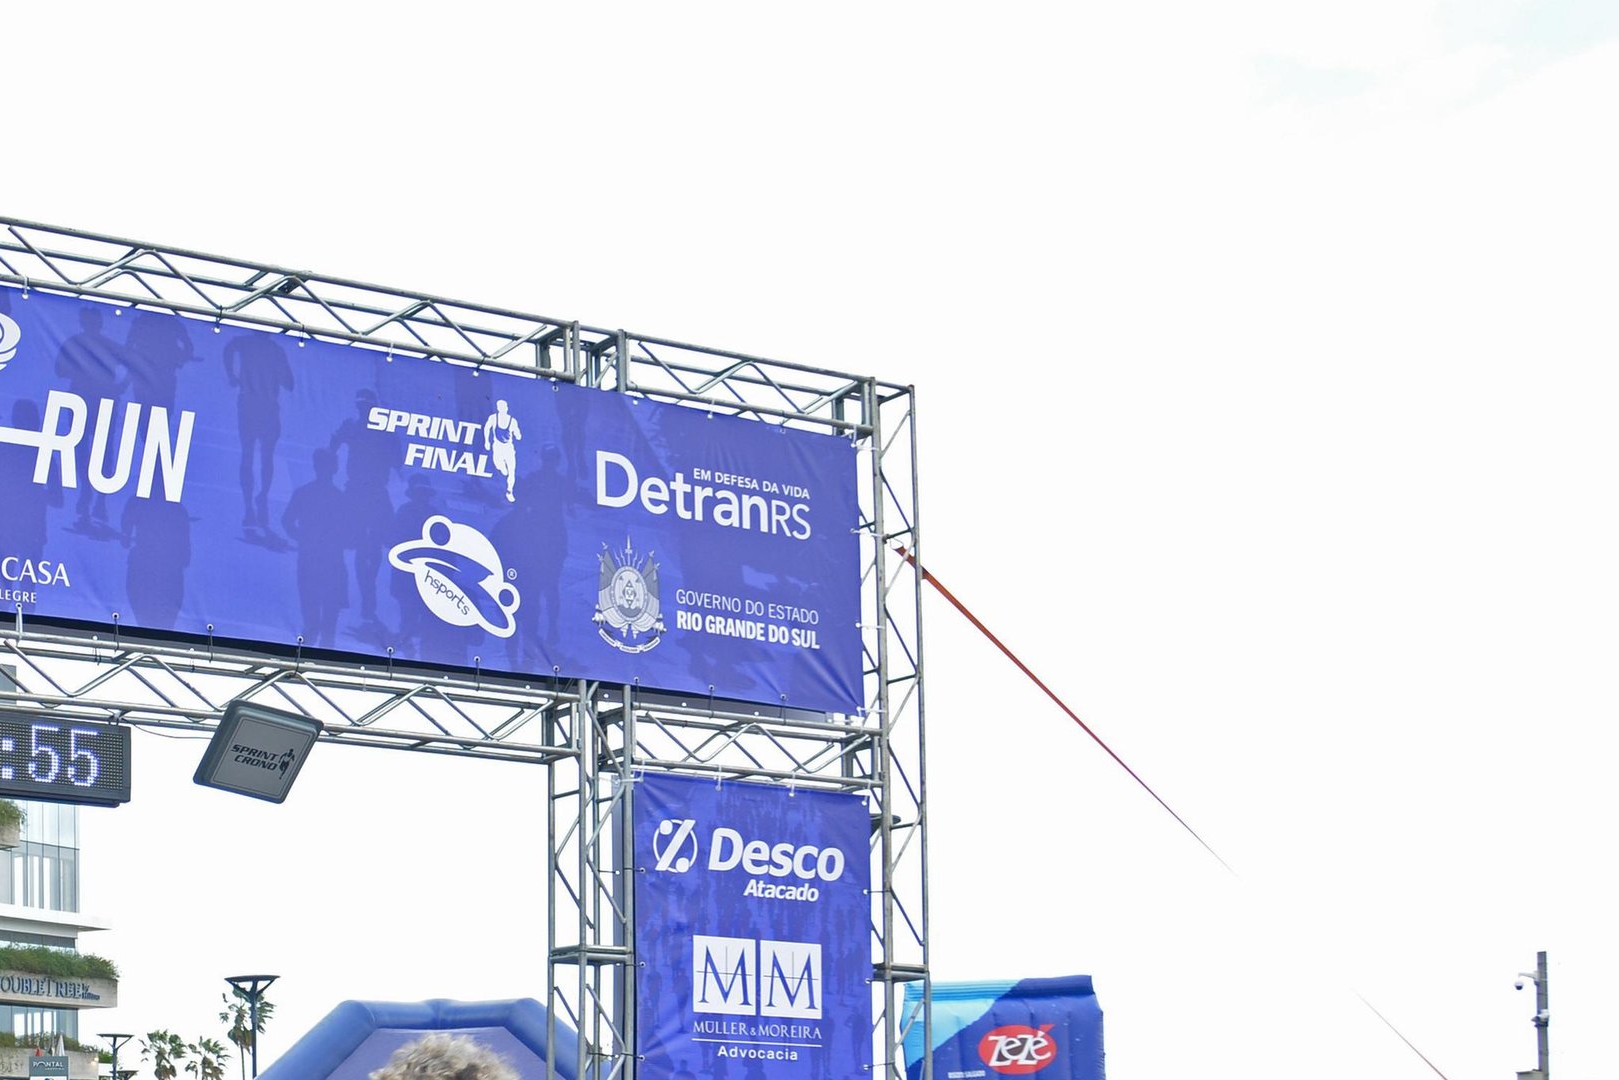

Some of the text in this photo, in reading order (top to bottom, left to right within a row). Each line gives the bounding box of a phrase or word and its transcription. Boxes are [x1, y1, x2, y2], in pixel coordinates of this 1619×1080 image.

[367, 407, 481, 444] SPRINT
[33, 389, 195, 503] RUN
[404, 442, 493, 478] FINAL
[693, 467, 810, 500] EM DEFESA DA VIDA
[1, 556, 71, 587] CASA
[676, 588, 819, 625] GOVERNO DO ESTADO
[676, 610, 820, 650] RIO GRANDE DO SUL
[231, 744, 279, 760] SPRINT
[234, 754, 278, 771] CRONO
[707, 827, 845, 882] Desco
[743, 878, 819, 902] Atacado
[717, 1045, 798, 1061] Advocacia
